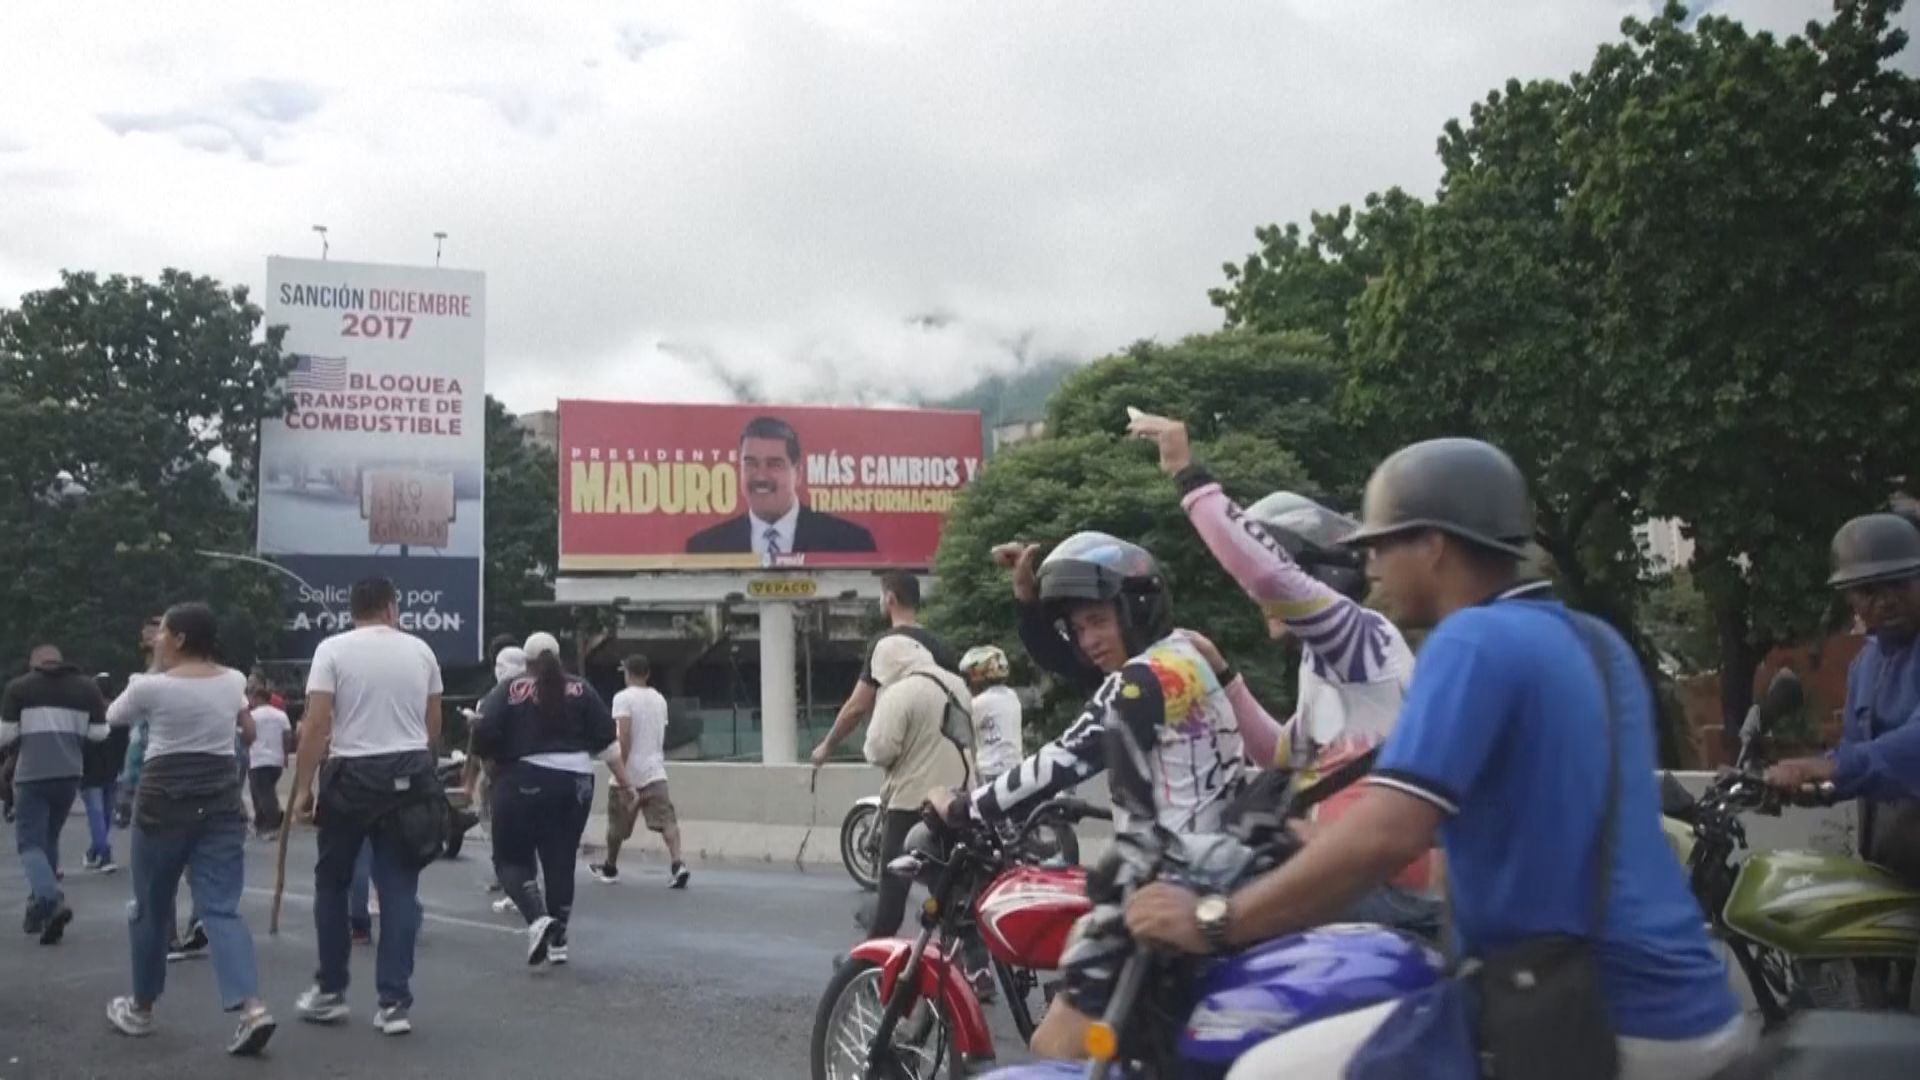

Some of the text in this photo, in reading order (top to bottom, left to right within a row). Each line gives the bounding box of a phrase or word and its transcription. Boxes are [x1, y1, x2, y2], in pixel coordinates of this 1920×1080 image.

[280, 282, 471, 317] SANCIÓN DICIEMBRE
[341, 314, 413, 339] 2017
[350, 373, 463, 394] BLOQUEA
[288, 392, 462, 413] TRANSPORTE DE
[285, 411, 462, 435] COMBUSTIBLE
[571, 447, 738, 462] PRESIDENTE
[807, 449, 978, 487] MÁS CAMBIOS Y
[571, 461, 737, 514] MADURO
[408, 590, 442, 606] por
[293, 612, 311, 631] A
